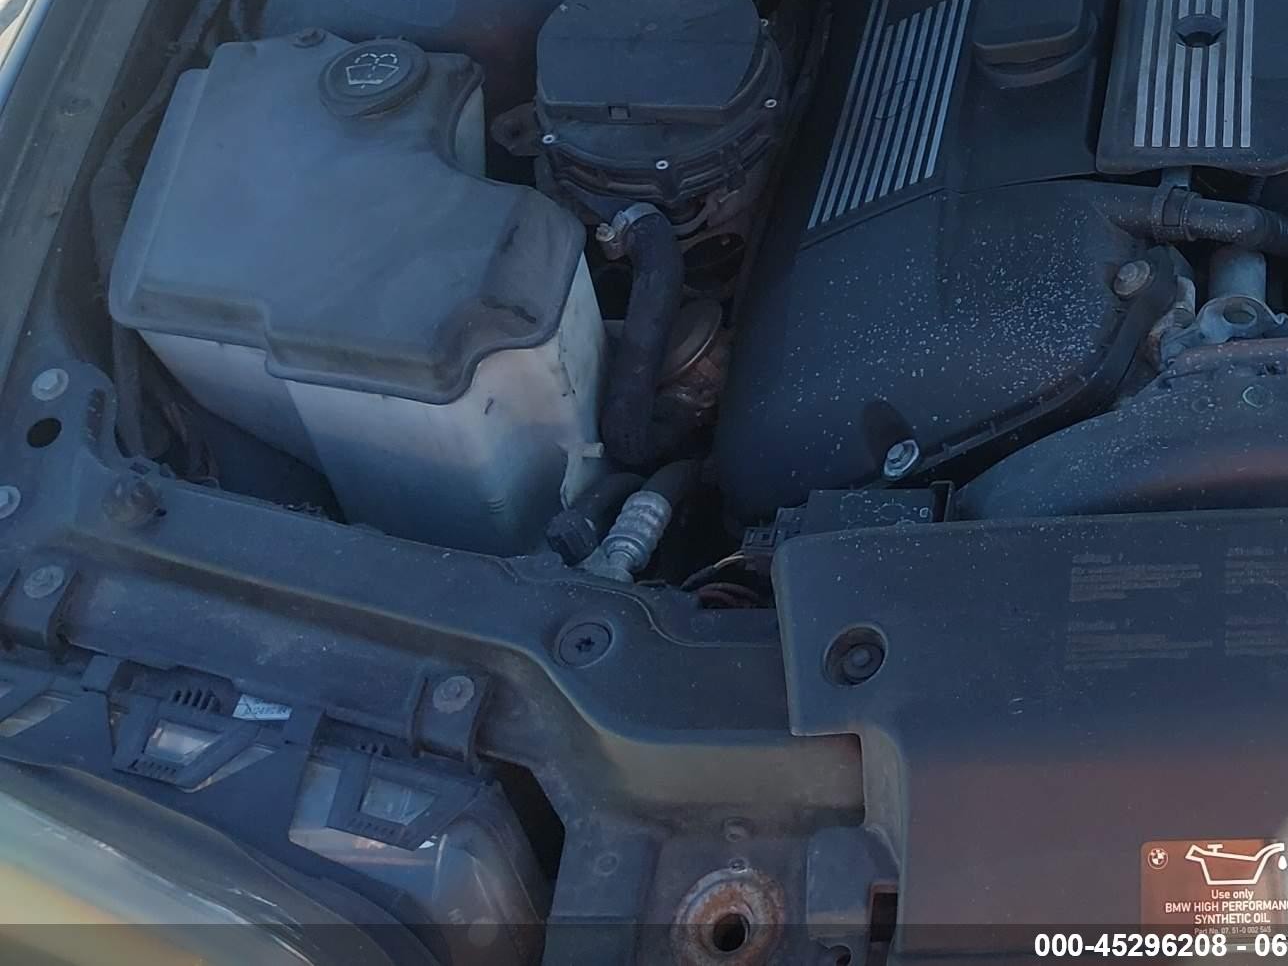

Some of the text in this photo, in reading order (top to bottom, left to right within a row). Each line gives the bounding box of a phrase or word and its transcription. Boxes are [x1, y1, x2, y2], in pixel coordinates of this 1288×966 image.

[1211, 888, 1254, 900] Use only
[1165, 902, 1191, 913] BMW
[1193, 901, 1219, 912] HIGH
[1194, 912, 1271, 925] SYNTHETIC OIL
[1194, 927, 1208, 935] Part
